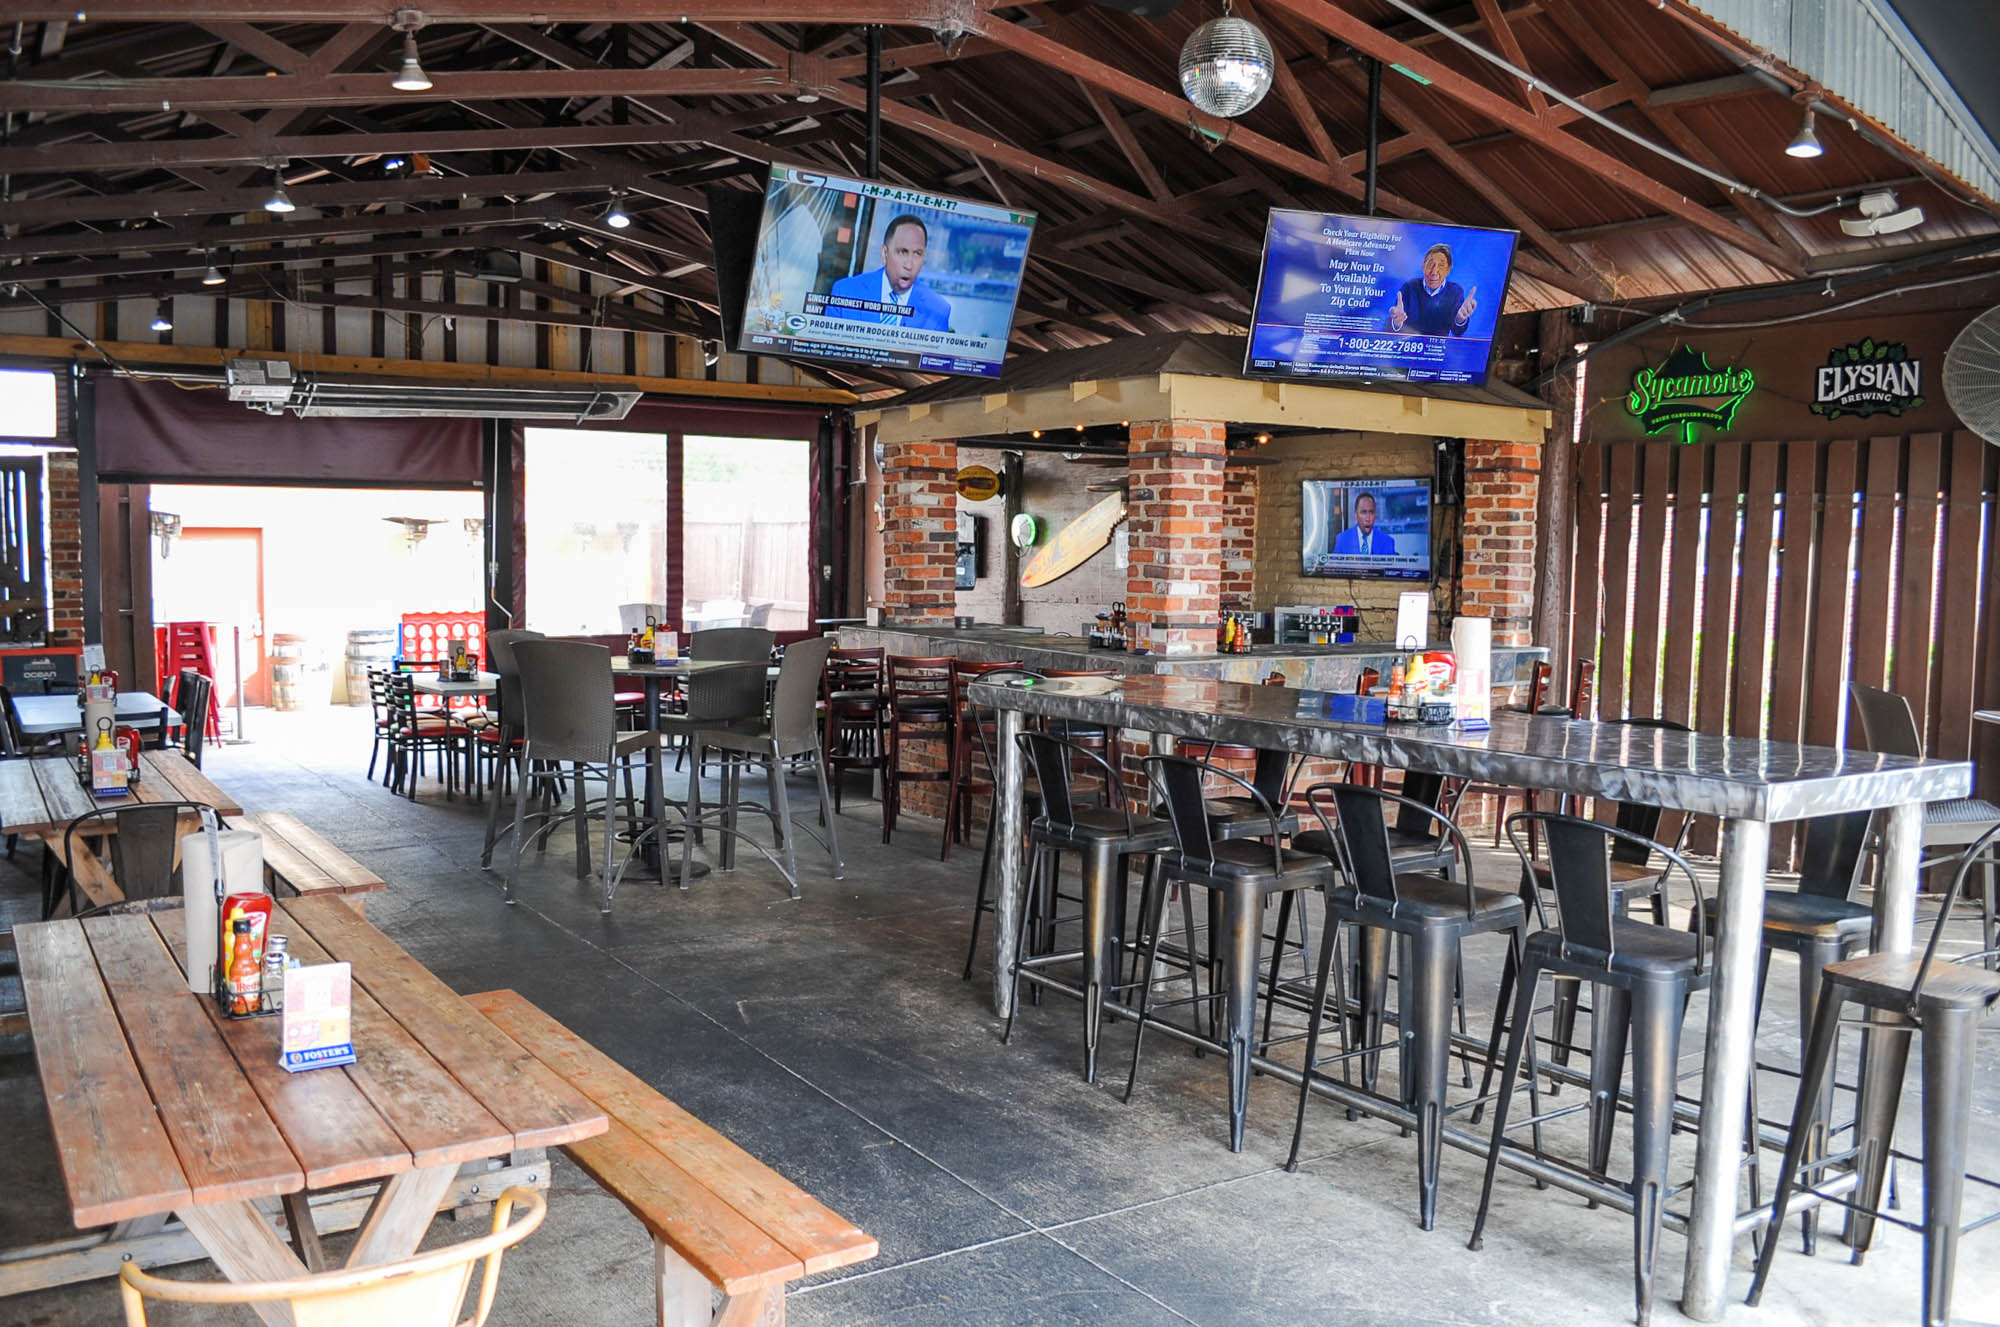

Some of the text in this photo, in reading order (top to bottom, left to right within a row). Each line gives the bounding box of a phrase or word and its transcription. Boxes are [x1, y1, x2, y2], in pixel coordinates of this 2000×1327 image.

[861, 184, 958, 211] I-M-P-A-T-I-E-N-T?
[1329, 259, 1349, 272] May
[1350, 261, 1371, 272] Now
[1333, 272, 1376, 284] Available
[1320, 283, 1386, 297] To You In Your
[1330, 295, 1371, 308] Zip Code
[809, 319, 844, 332] PROBLEM
[845, 323, 865, 334] WITH
[866, 327, 899, 338] RODGERS
[900, 331, 929, 342] CALLING
[930, 335, 945, 344] OUT
[945, 337, 969, 348] YOUNG
[1817, 360, 1920, 402] ELYSIAN
[1626, 368, 1754, 415] Sycamore
[1841, 392, 1892, 405] BREWING
[303, 1046, 350, 1061] FOSTER'S
